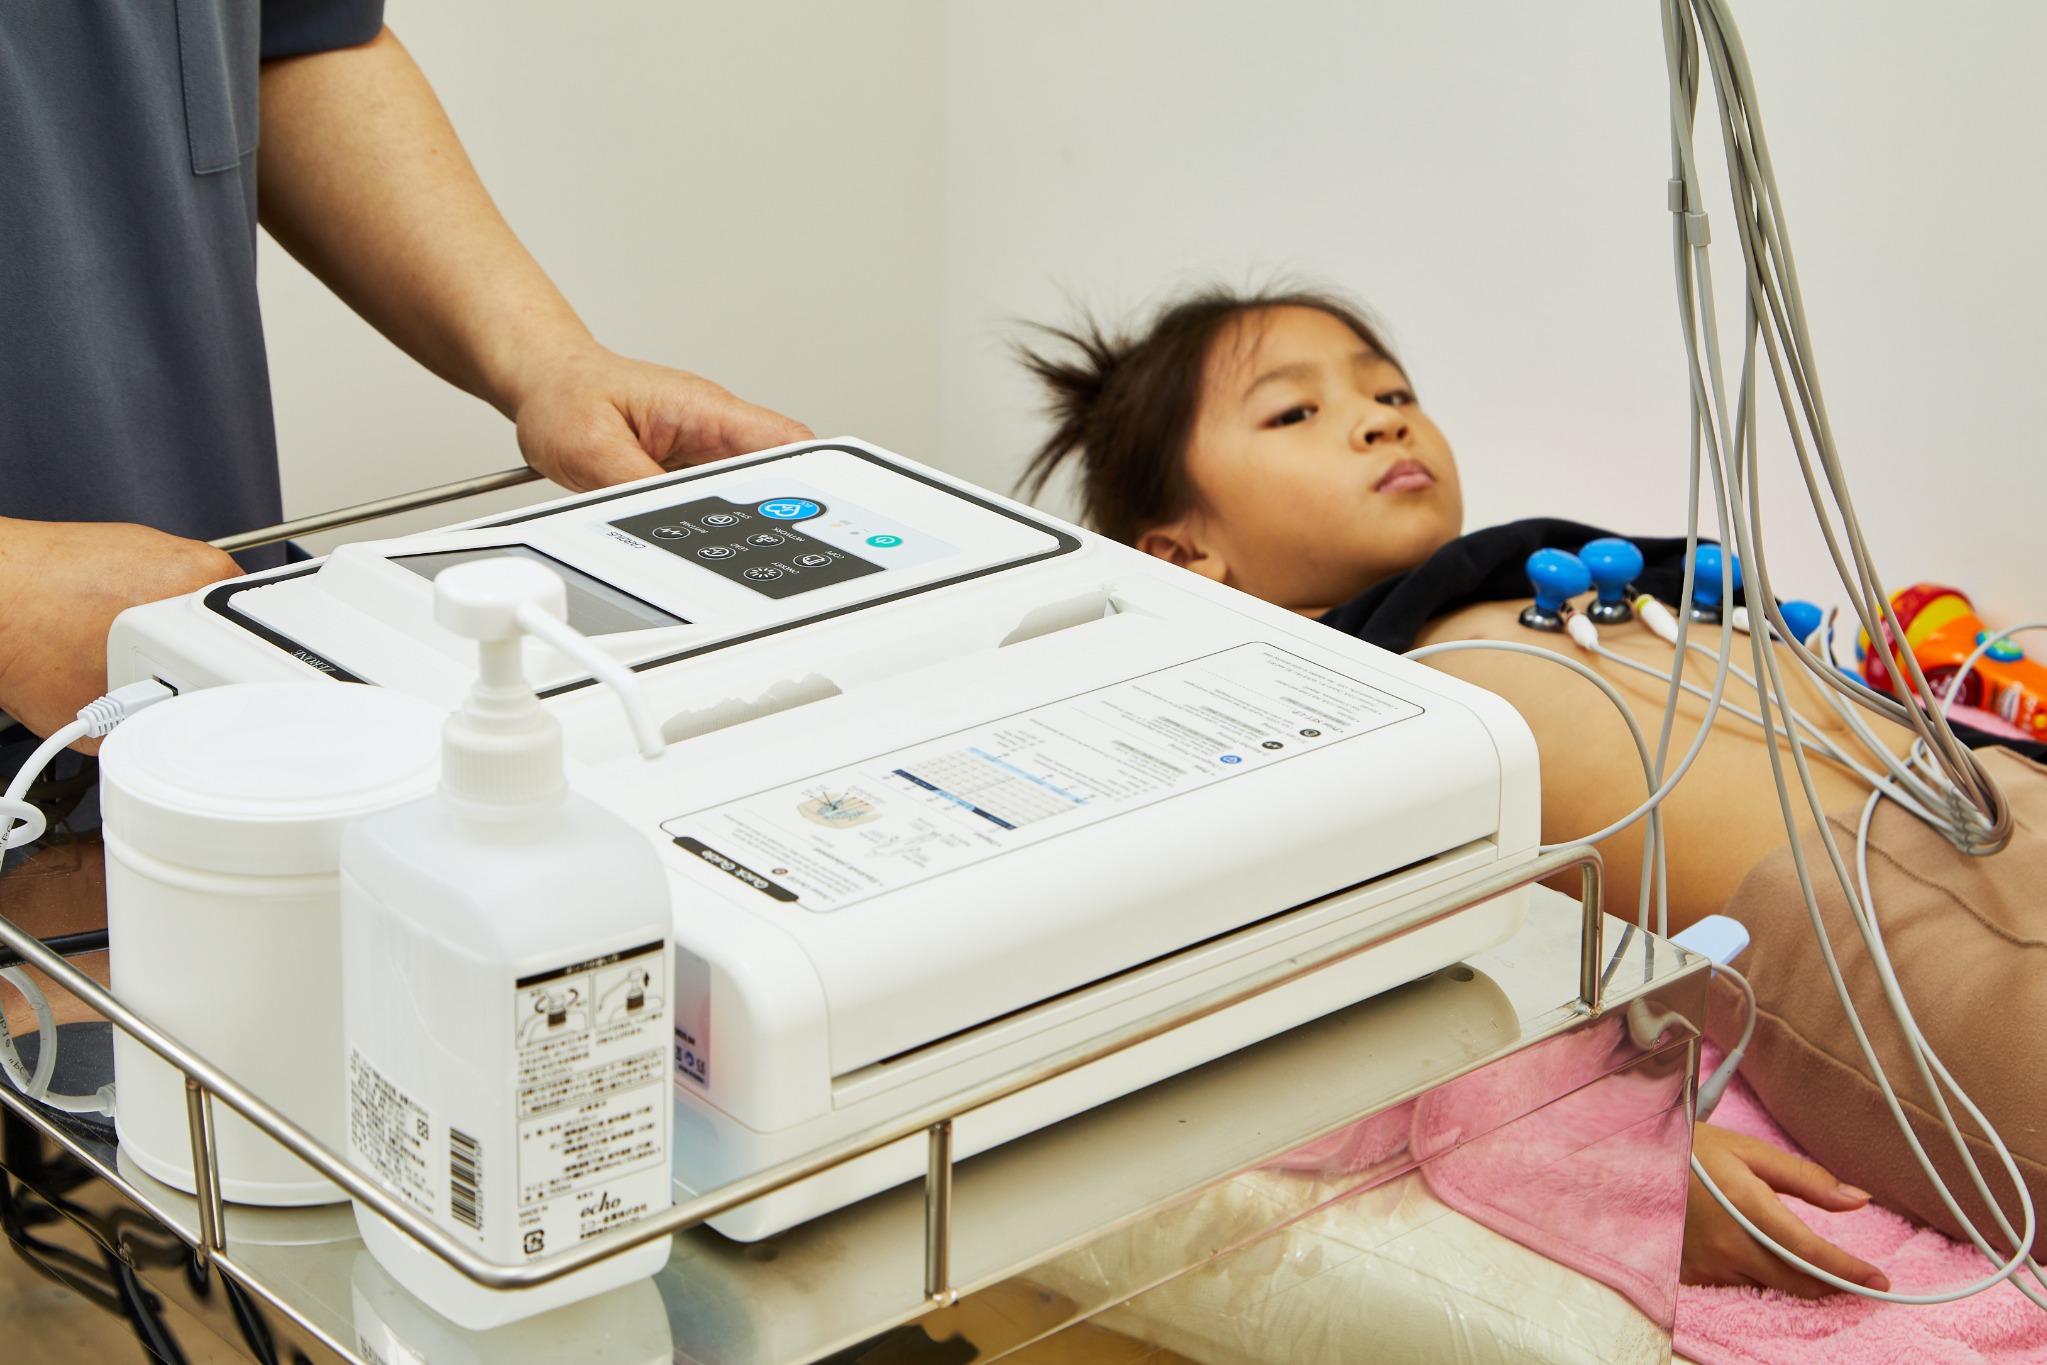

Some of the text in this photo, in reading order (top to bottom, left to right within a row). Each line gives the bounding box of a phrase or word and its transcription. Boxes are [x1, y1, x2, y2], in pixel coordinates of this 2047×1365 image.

[733, 511, 753, 520] STOP
[771, 527, 806, 543] NETWORK
[730, 543, 750, 552] LEAD
[825, 550, 845, 560] COPY
[701, 850, 769, 889] Quick Guide
[580, 1191, 622, 1219] echo
